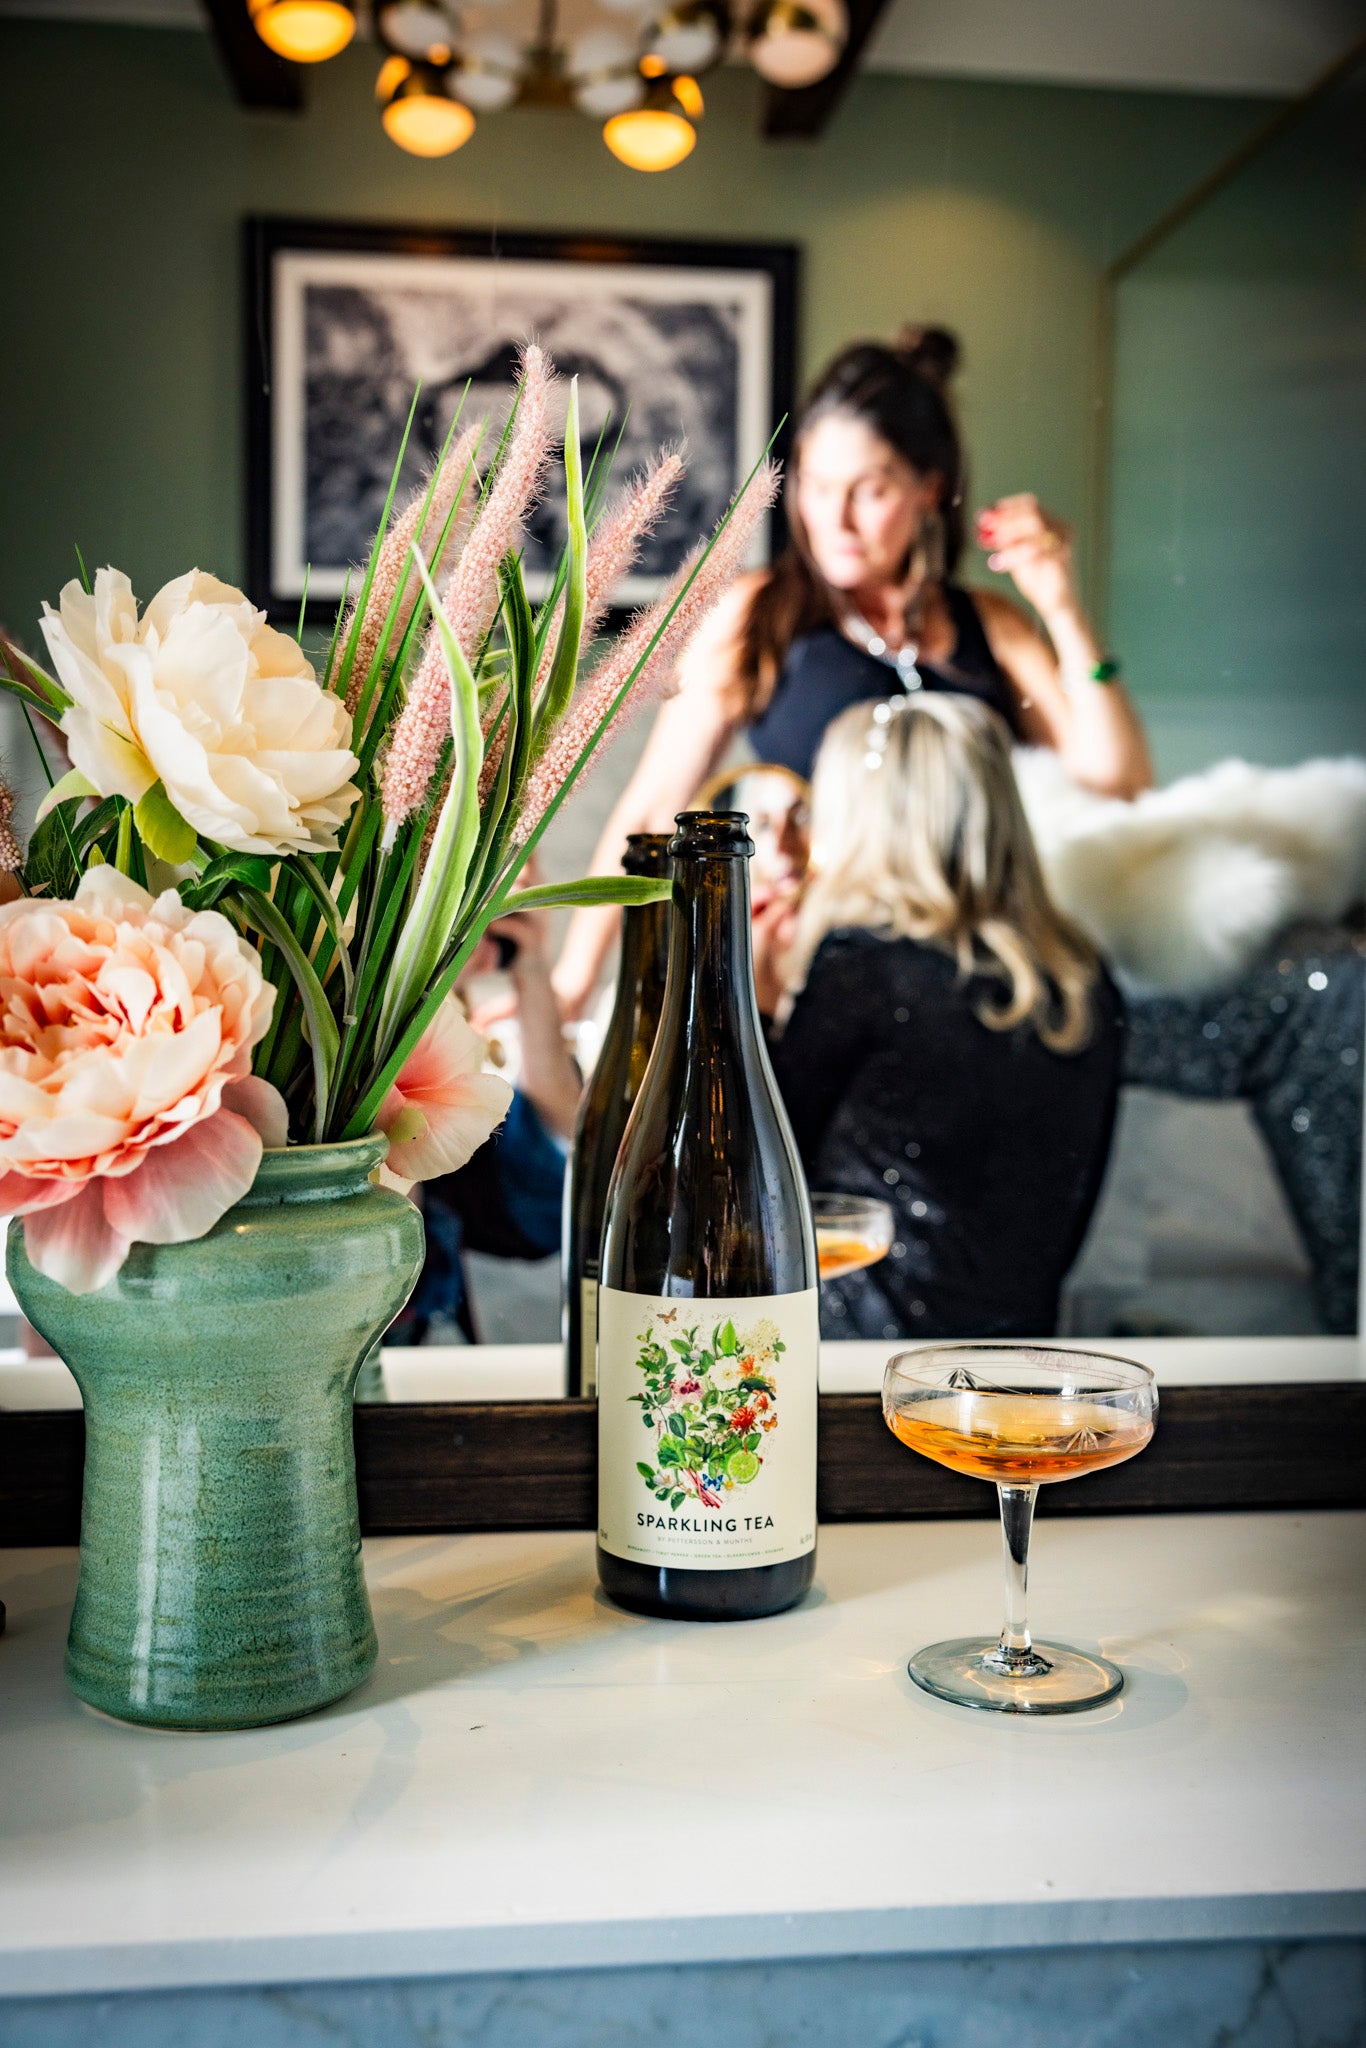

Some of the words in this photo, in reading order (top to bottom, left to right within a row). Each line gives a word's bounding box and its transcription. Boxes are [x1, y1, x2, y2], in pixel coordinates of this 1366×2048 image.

[637, 1513, 737, 1532] SPARKLING
[744, 1515, 774, 1531] TEA
[668, 1537, 714, 1545] PETTERSSON
